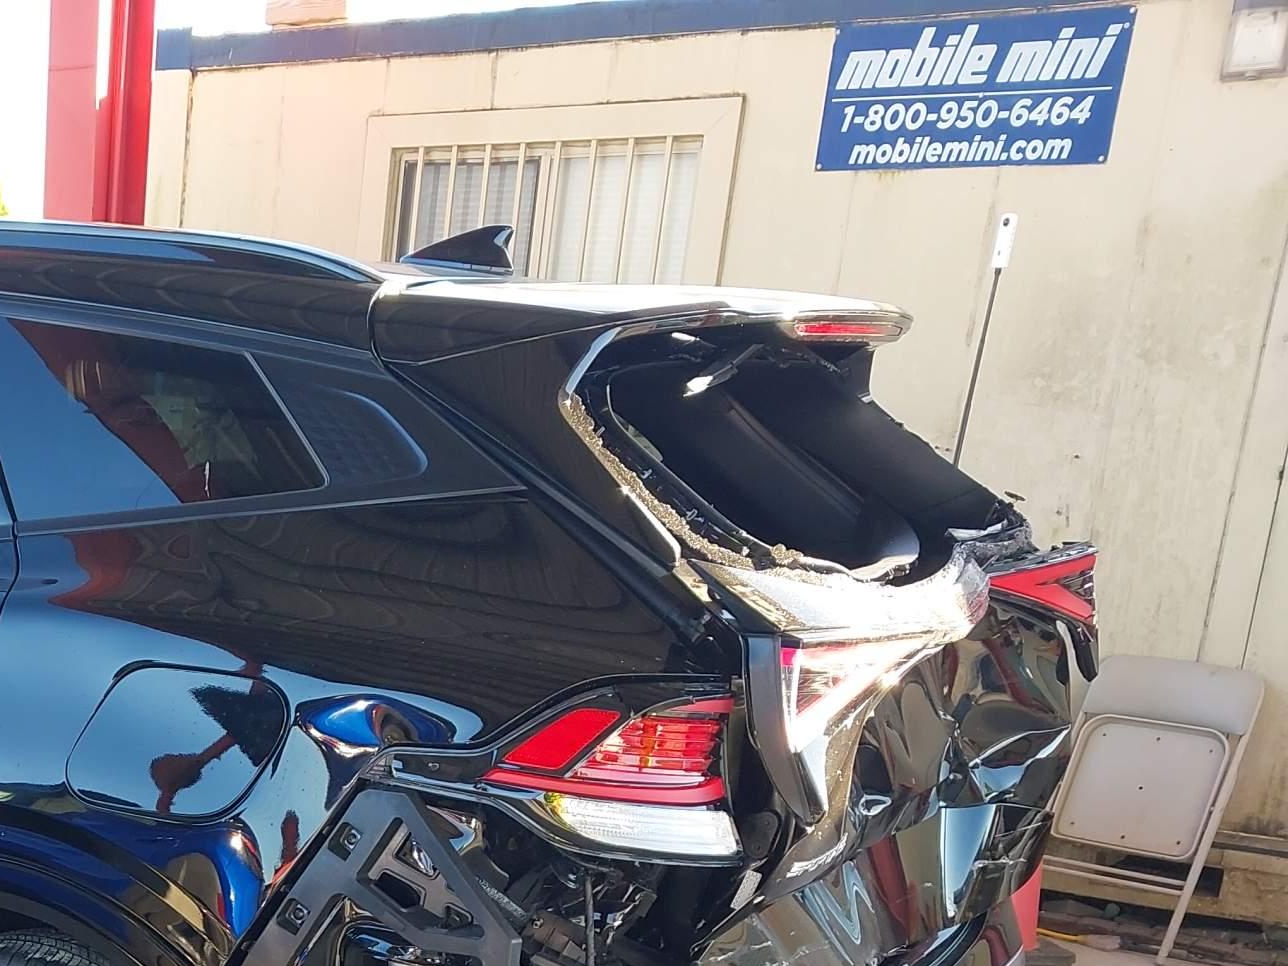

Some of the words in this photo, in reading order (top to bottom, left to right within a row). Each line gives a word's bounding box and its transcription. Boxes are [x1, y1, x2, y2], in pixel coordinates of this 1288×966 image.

[835, 24, 998, 90] mobile
[995, 23, 1124, 83] mini
[840, 95, 1095, 133] 1-800-950-6464
[848, 134, 1073, 165] mobilemini.com
